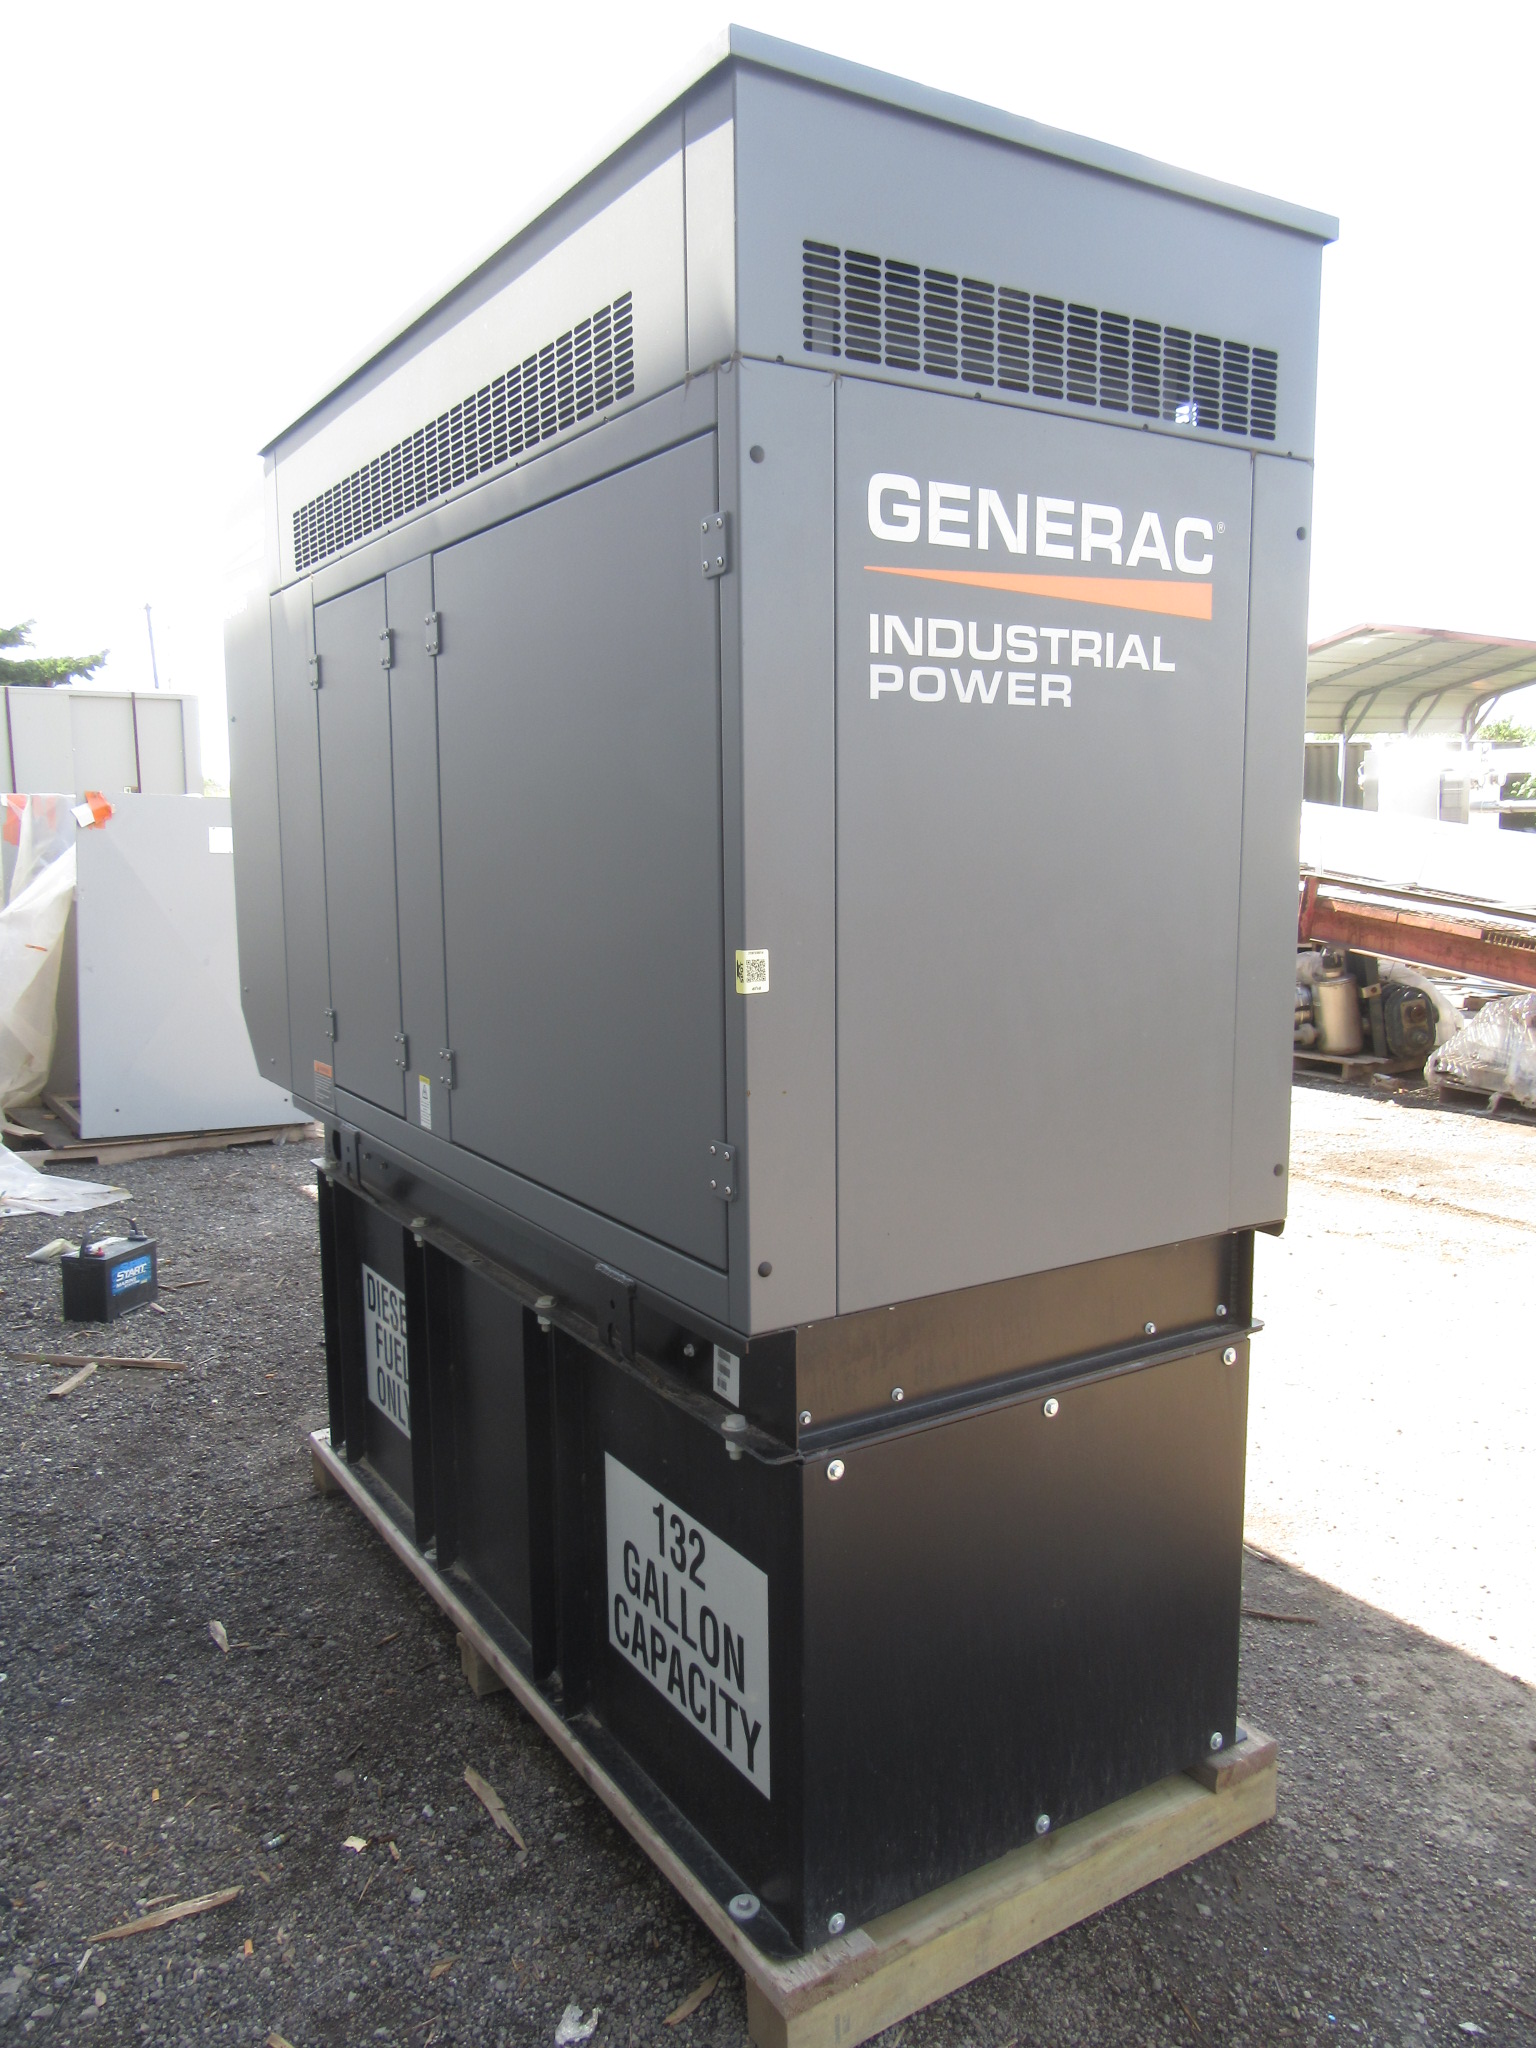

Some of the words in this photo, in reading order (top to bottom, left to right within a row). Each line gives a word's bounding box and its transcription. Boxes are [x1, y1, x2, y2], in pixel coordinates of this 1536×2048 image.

[869, 613, 1176, 673] INDUSTRIAL
[869, 663, 1073, 708] POWER
[116, 1263, 147, 1282] START
[367, 1271, 407, 1338] DIESE
[652, 1502, 706, 1592] 132
[623, 1540, 745, 1695] GALLON
[614, 1593, 762, 1774] CAPACITY
